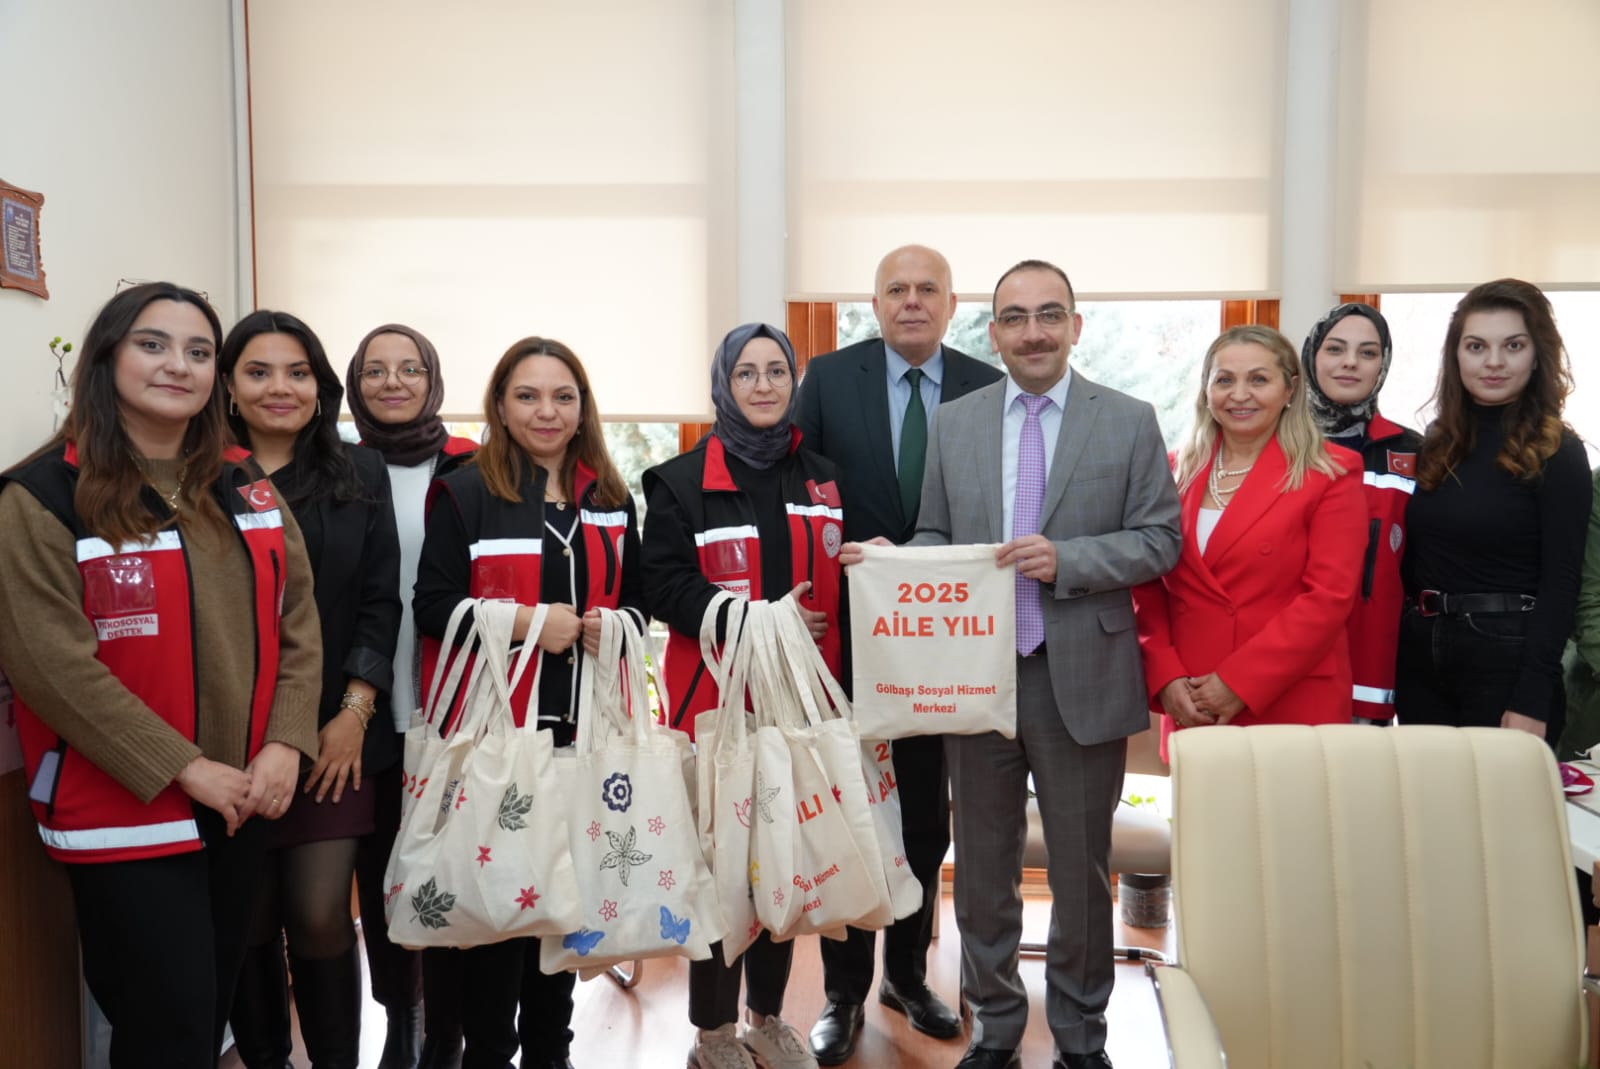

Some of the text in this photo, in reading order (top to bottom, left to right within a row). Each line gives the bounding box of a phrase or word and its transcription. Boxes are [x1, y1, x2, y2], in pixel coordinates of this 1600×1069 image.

[897, 582, 970, 603] 2025
[872, 611, 994, 637] AİLE YILI
[108, 628, 143, 639] DESTEK
[875, 683, 997, 697] Gölbaşı Sosyal Hizmet
[913, 702, 956, 714] Merkezi
[813, 863, 840, 887] Hizmet
